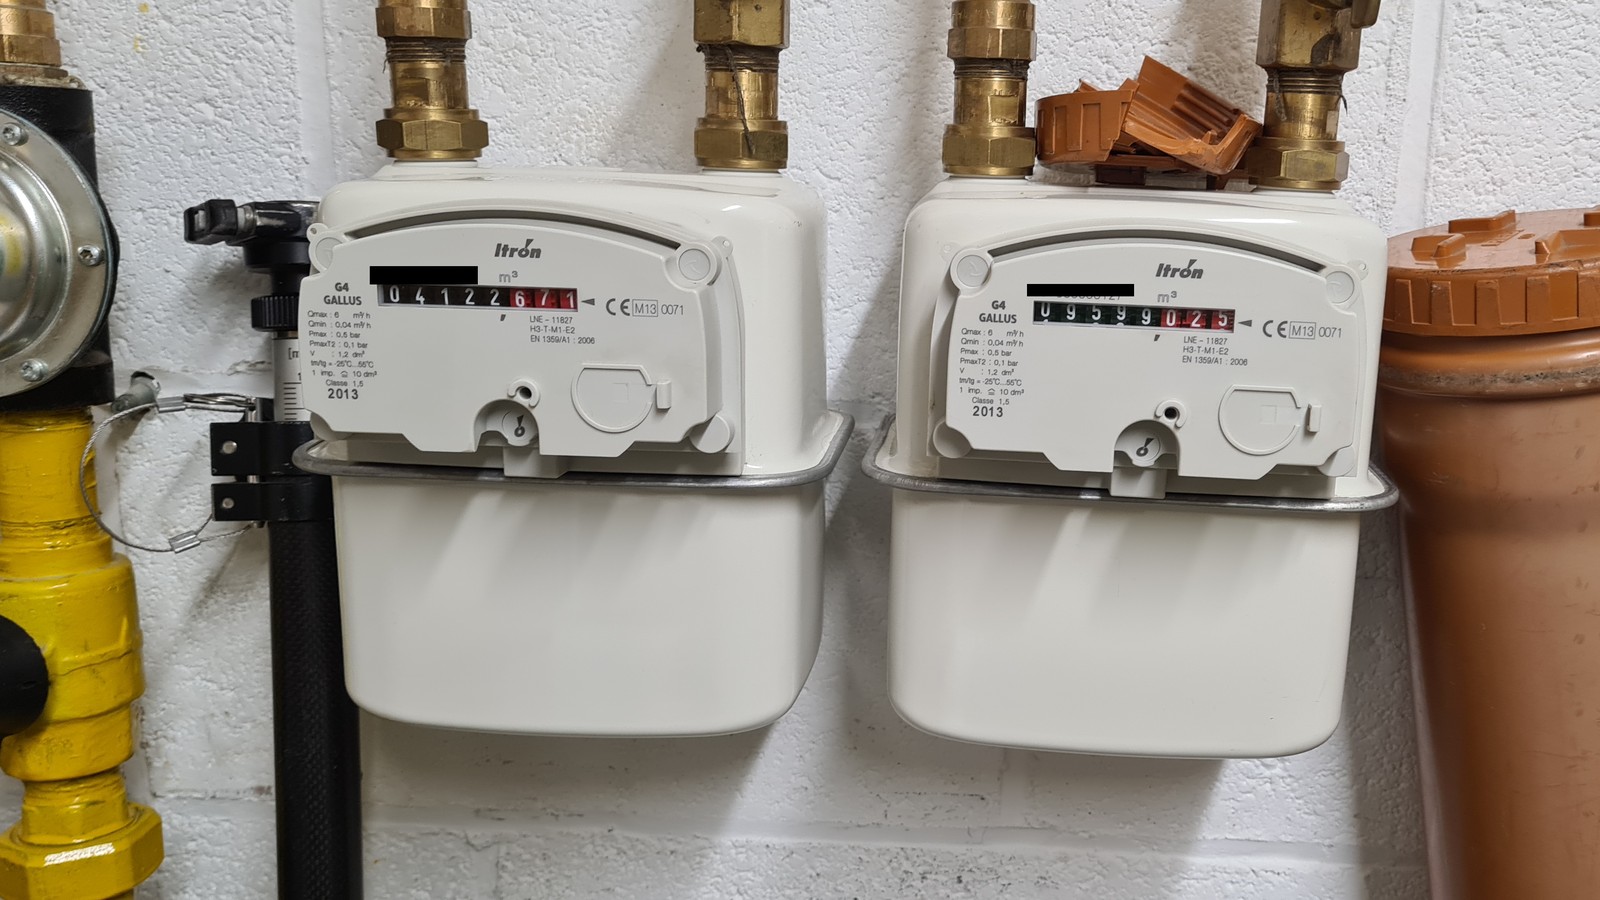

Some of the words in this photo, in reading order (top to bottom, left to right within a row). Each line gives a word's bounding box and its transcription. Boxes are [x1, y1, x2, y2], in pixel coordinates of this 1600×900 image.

[334, 282, 349, 292] G4
[323, 295, 362, 306] GALLUS
[991, 300, 1006, 310] G4
[307, 310, 328, 319] Qmax
[334, 311, 340, 319] 6
[634, 303, 658, 315] M13
[661, 303, 684, 316] 0071
[529, 315, 543, 324] LNE
[552, 316, 573, 325] 11827
[979, 313, 1017, 324] GALLUS
[308, 320, 327, 328] Qmin
[308, 330, 327, 338] Pmax
[349, 331, 361, 339] bar
[529, 325, 576, 335] H3-T-M1-E2
[961, 327, 981, 336] Qmax
[1291, 326, 1314, 337] M13
[1318, 326, 1342, 339] 0071
[356, 341, 368, 349] bar
[530, 335, 540, 343] EN
[542, 335, 570, 345] 1359/A1
[577, 336, 596, 345] 2006
[960, 337, 979, 346] Qmin
[1183, 336, 1197, 344] LNE
[1206, 336, 1228, 346] 11827
[960, 347, 979, 355] Pmax
[1001, 349, 1012, 357] bar
[1182, 346, 1229, 356] H3-T-M1-E2
[1007, 359, 1018, 367] bar
[1182, 355, 1192, 363] EN
[1194, 356, 1223, 366] 1359/A1
[1230, 357, 1248, 366] 2006
[352, 370, 362, 378] 10
[325, 379, 348, 387] Classe
[327, 388, 359, 400] 2013
[1000, 388, 1009, 396] 10
[971, 397, 994, 405] Classe
[972, 405, 1004, 417] 2013
